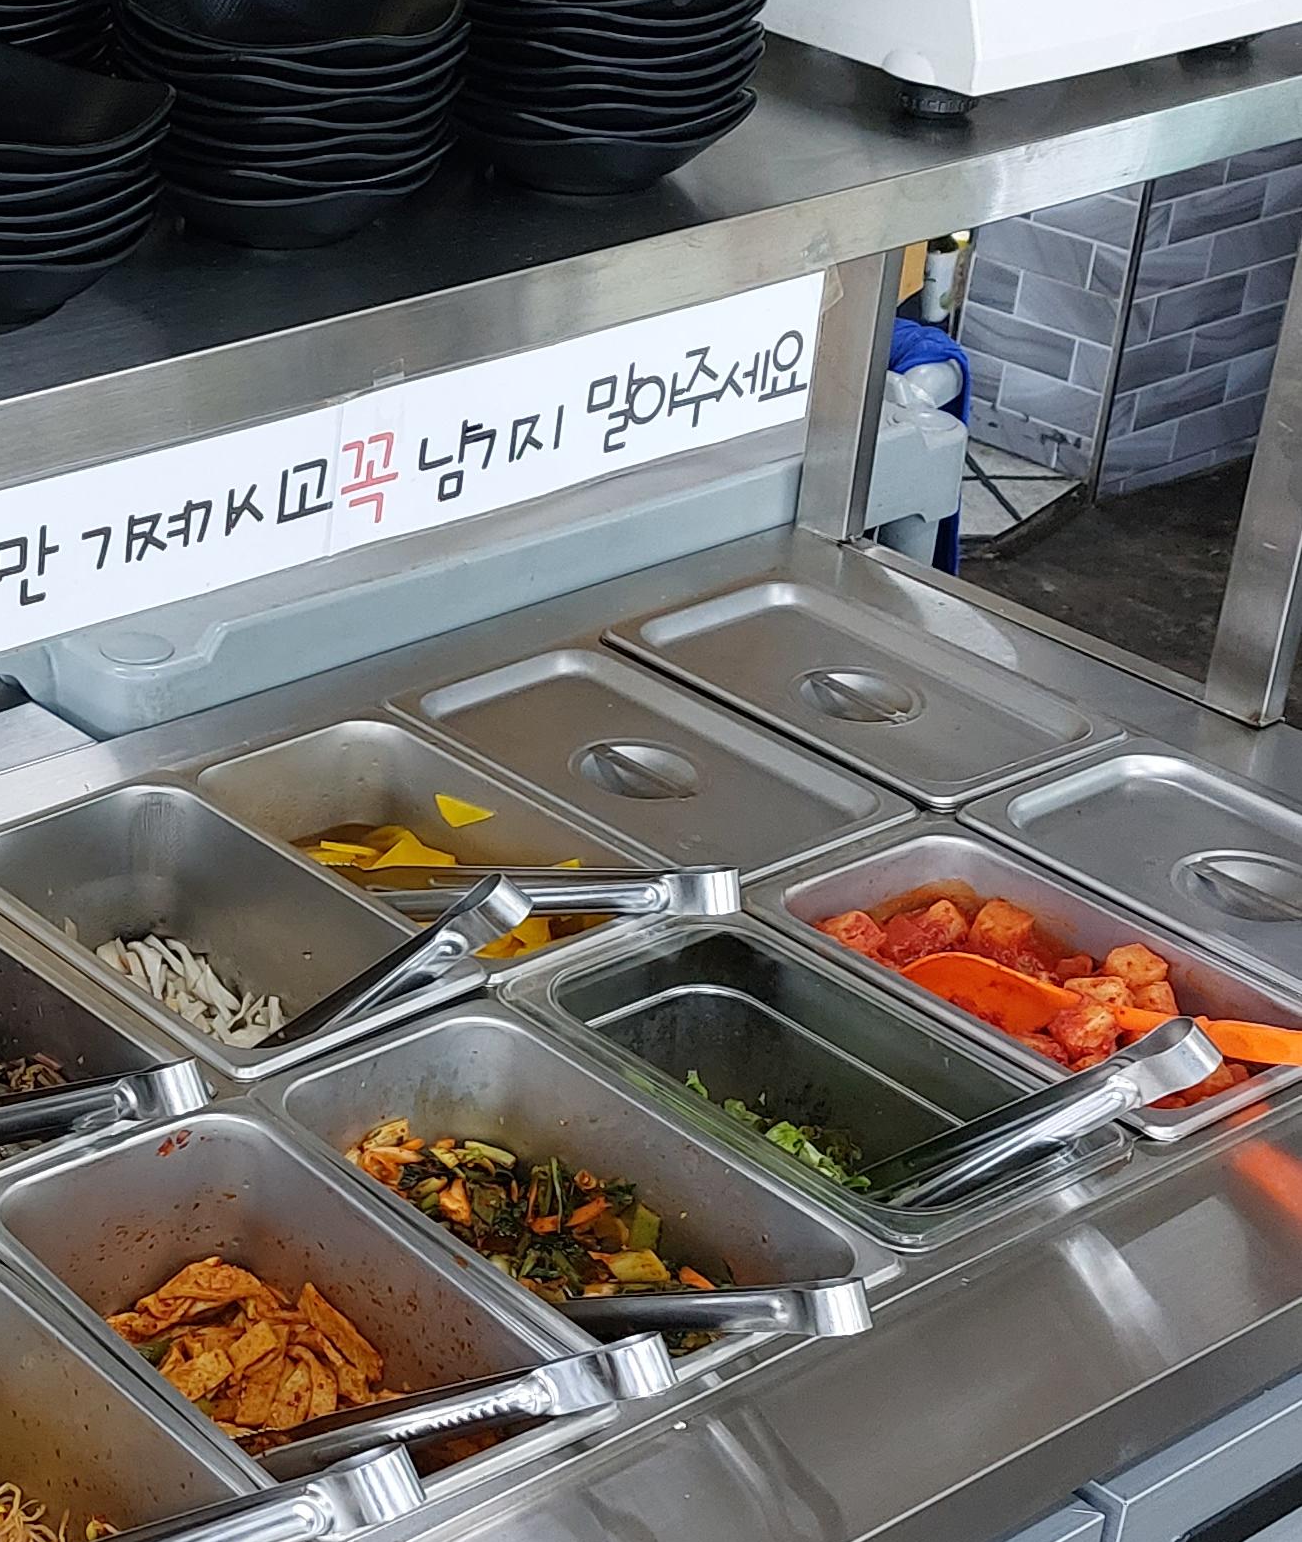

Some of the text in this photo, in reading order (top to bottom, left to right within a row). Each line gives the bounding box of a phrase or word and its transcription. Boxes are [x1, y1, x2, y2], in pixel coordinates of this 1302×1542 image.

[81, 458, 333, 571] 가져가시고
[340, 431, 399, 524] 꼭
[418, 404, 565, 502] 남기지
[586, 329, 808, 453] 말아주세요
